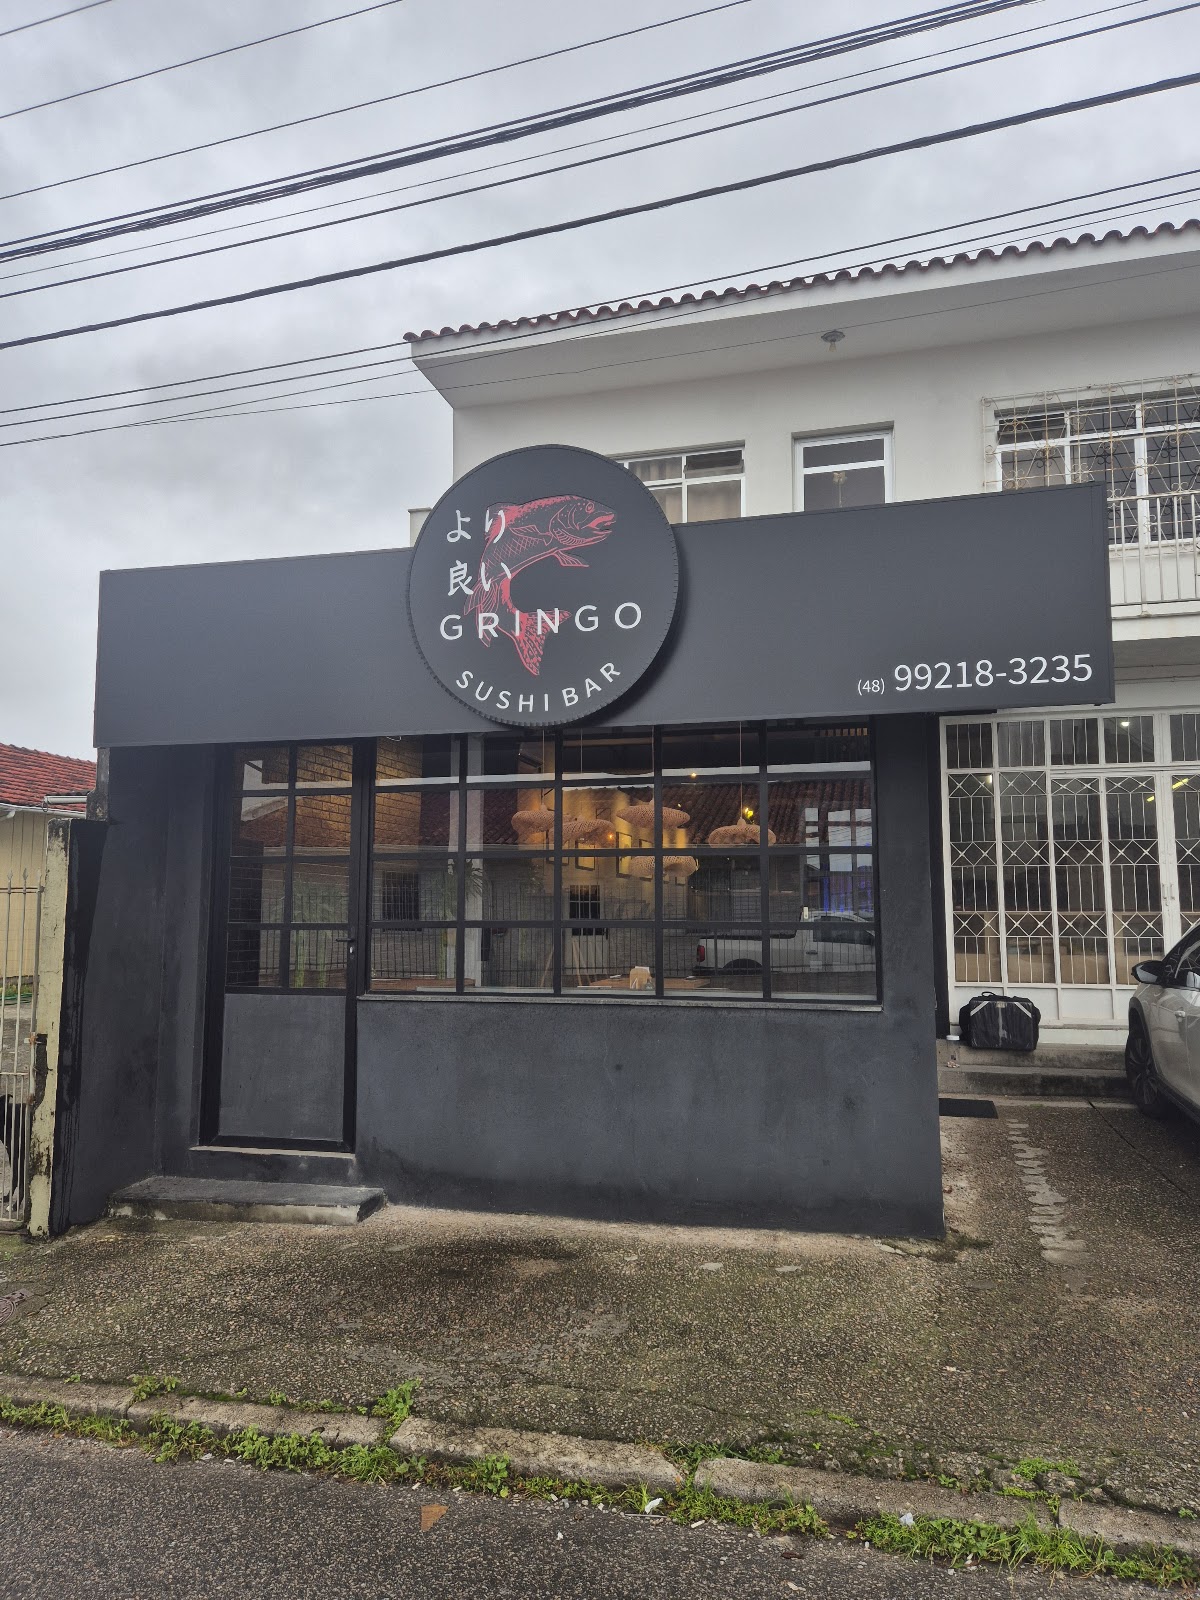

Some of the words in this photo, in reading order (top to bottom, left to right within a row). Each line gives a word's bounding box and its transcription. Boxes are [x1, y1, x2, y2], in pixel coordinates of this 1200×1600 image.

[446, 509, 506, 543] より
[447, 560, 512, 596] 良い
[439, 602, 642, 640] GRINGO
[455, 670, 549, 712] SUSHI
[561, 662, 621, 707] BAR
[857, 678, 885, 695] (48)
[894, 653, 1093, 691] 99218-3235
